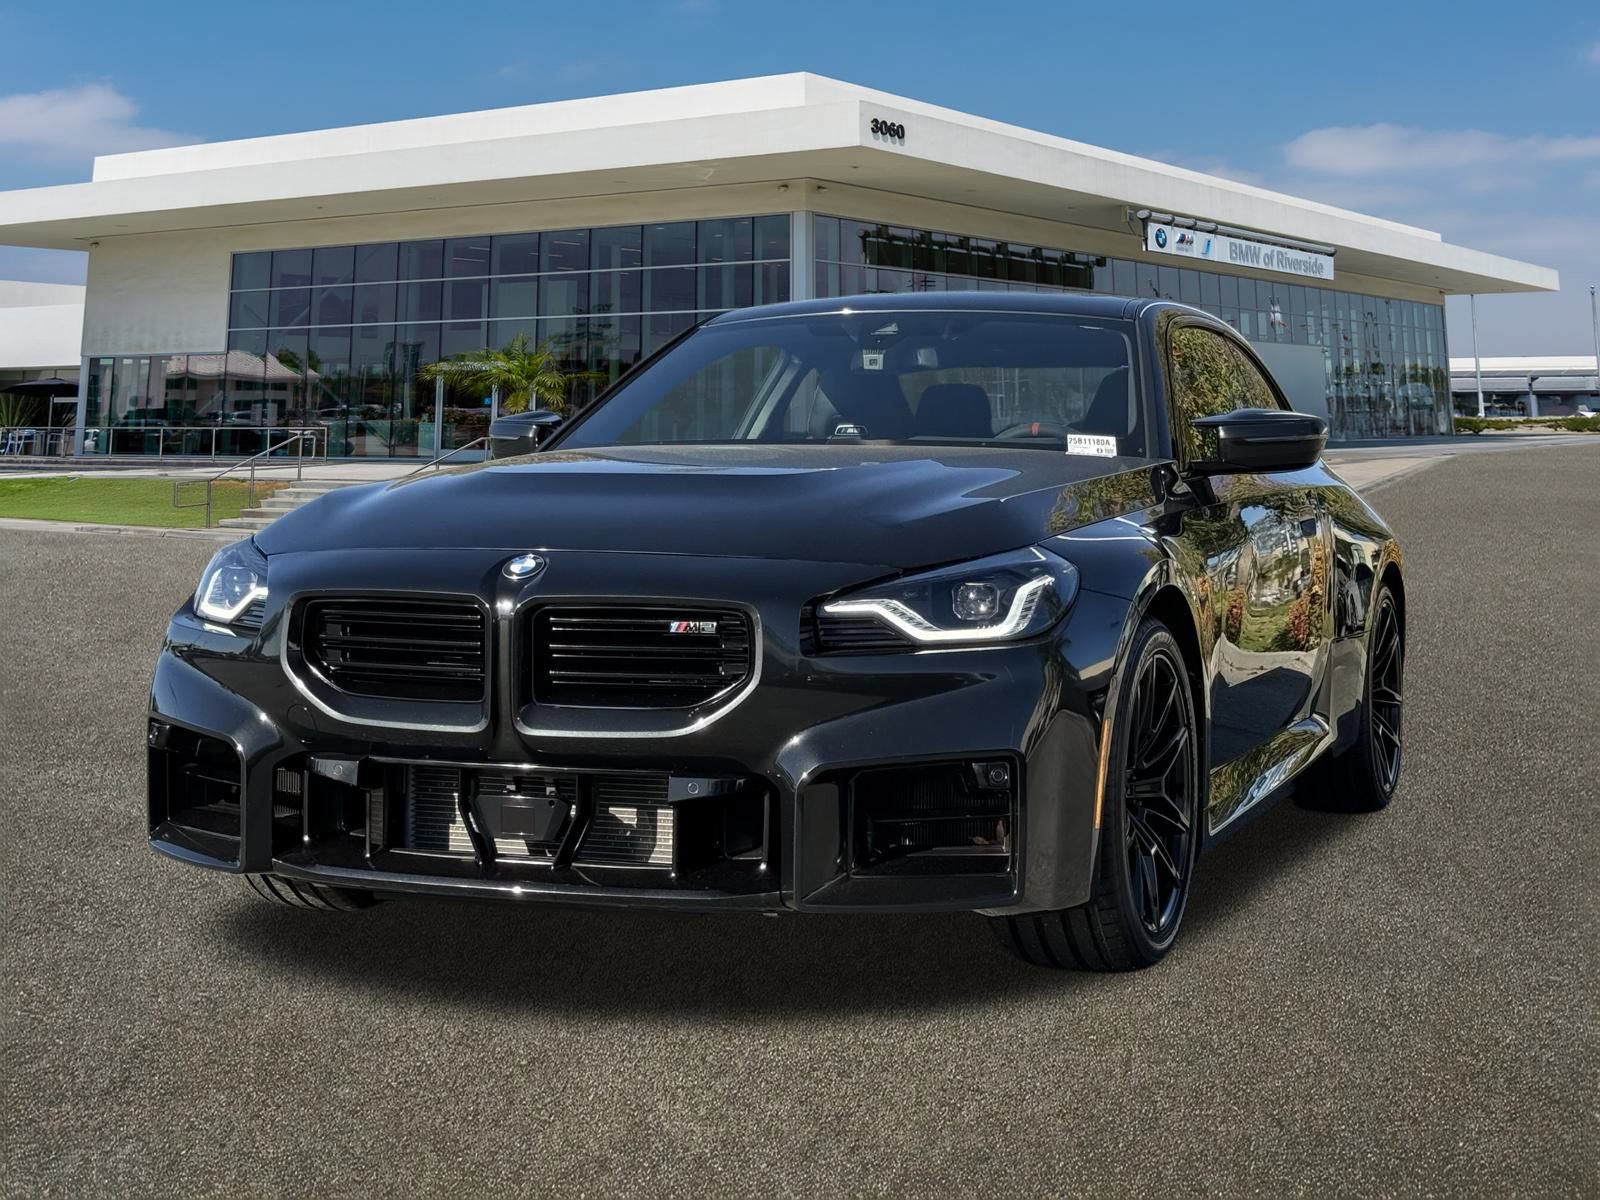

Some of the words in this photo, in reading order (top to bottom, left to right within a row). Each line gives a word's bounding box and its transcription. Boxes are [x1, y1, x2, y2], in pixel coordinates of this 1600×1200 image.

[871, 118, 905, 139] 3060
[1229, 241, 1261, 265] BMW
[1263, 249, 1275, 267] of
[1276, 250, 1324, 275] Riverside
